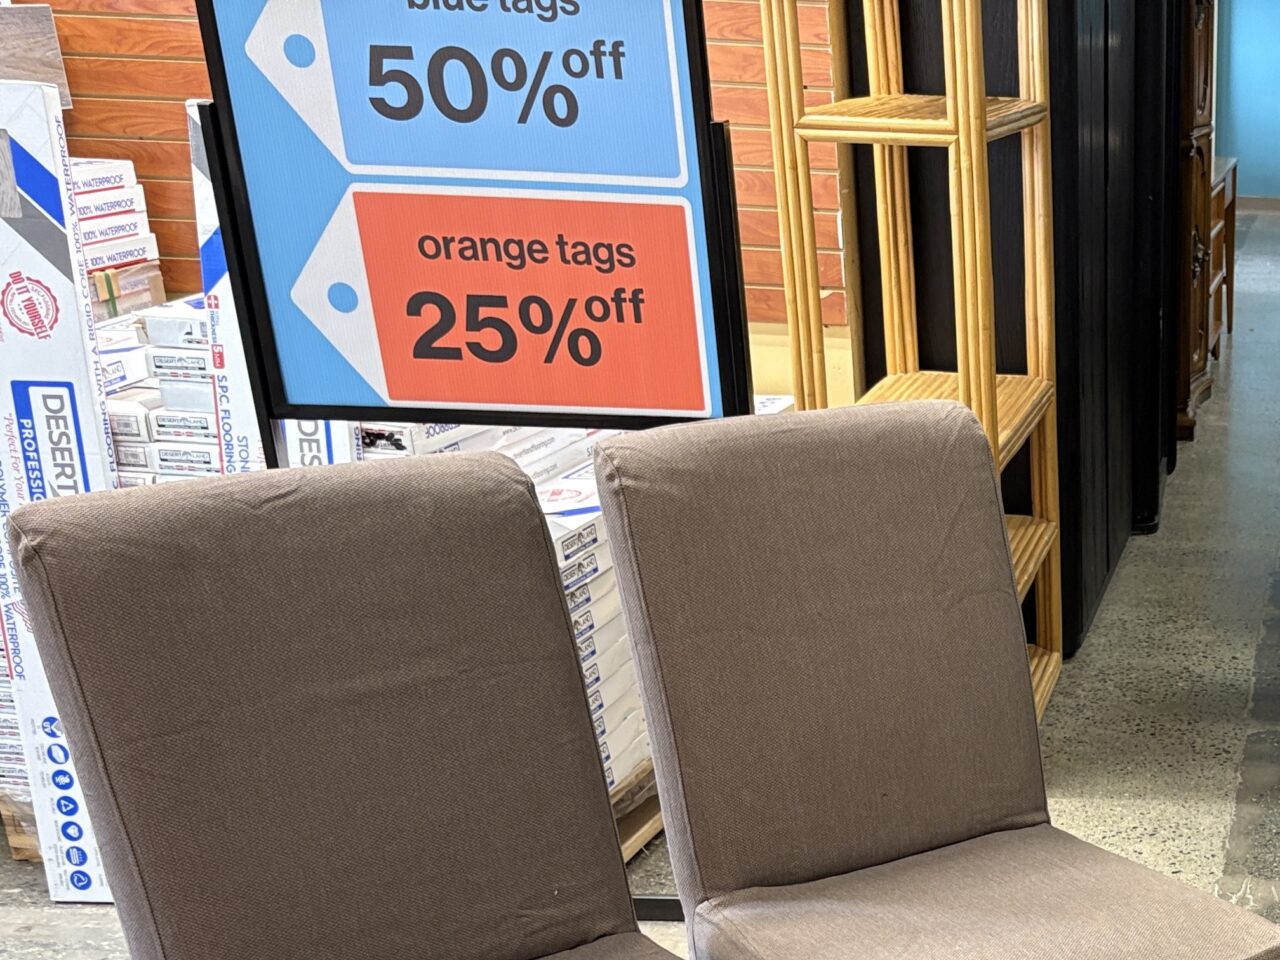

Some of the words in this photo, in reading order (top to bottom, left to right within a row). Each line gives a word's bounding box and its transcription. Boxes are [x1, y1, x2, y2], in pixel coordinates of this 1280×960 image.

[368, 45, 579, 128] 50%
[562, 39, 626, 80] off
[54, 115, 76, 216] WATERPROOF
[82, 174, 124, 188] WATERPROOF
[94, 198, 134, 212] WATERPROOF
[72, 221, 83, 254] 100%
[83, 230, 98, 241] 100%
[99, 222, 138, 237] WATERPROOF
[90, 256, 105, 266] 100%
[106, 247, 147, 263] WATERPROOF
[417, 234, 550, 270] orange
[556, 233, 637, 274] tags
[9, 271, 25, 285] DO
[15, 285, 31, 295] IT
[78, 259, 90, 298] CORE
[21, 296, 52, 340] YOURSELF
[84, 303, 96, 341] RIGID
[405, 290, 603, 367] 25%
[584, 287, 645, 323] off
[93, 360, 103, 397] WITH
[42, 394, 79, 494] DESERT
[100, 401, 117, 473] FLOORING
[221, 409, 236, 473] FLOORING
[237, 435, 250, 472] STON
[10, 455, 21, 473] For
[14, 476, 25, 501] Your
[4, 603, 26, 681] WATERPROOF
